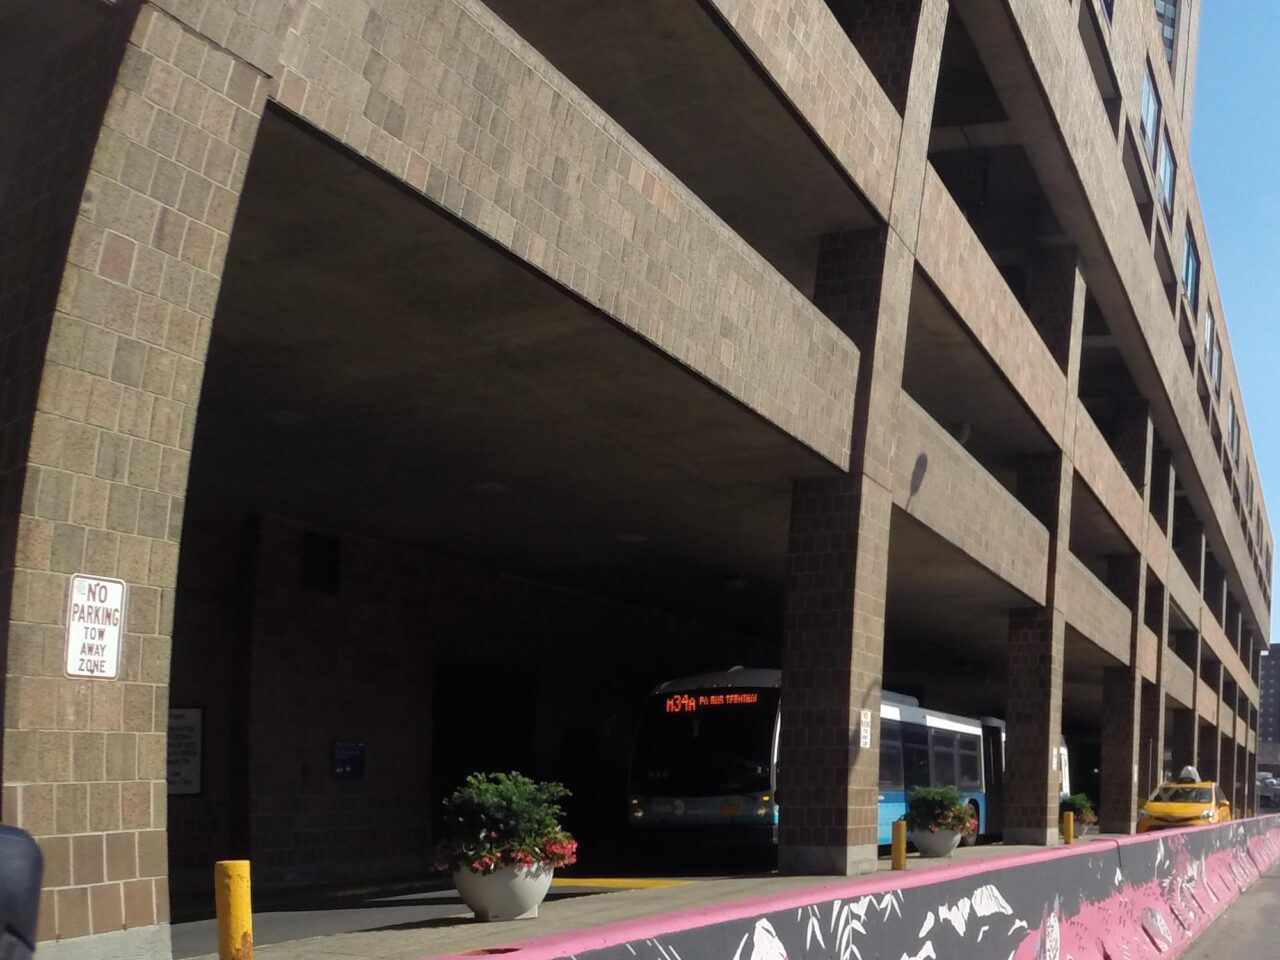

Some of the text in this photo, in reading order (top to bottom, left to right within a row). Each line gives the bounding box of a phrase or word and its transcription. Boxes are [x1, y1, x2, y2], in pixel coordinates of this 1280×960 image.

[87, 582, 108, 604] NO
[72, 603, 120, 627] PARKING
[84, 626, 106, 641] TOW
[80, 642, 107, 657] AWAY
[78, 658, 106, 675] ZONE
[666, 693, 696, 713] M34A
